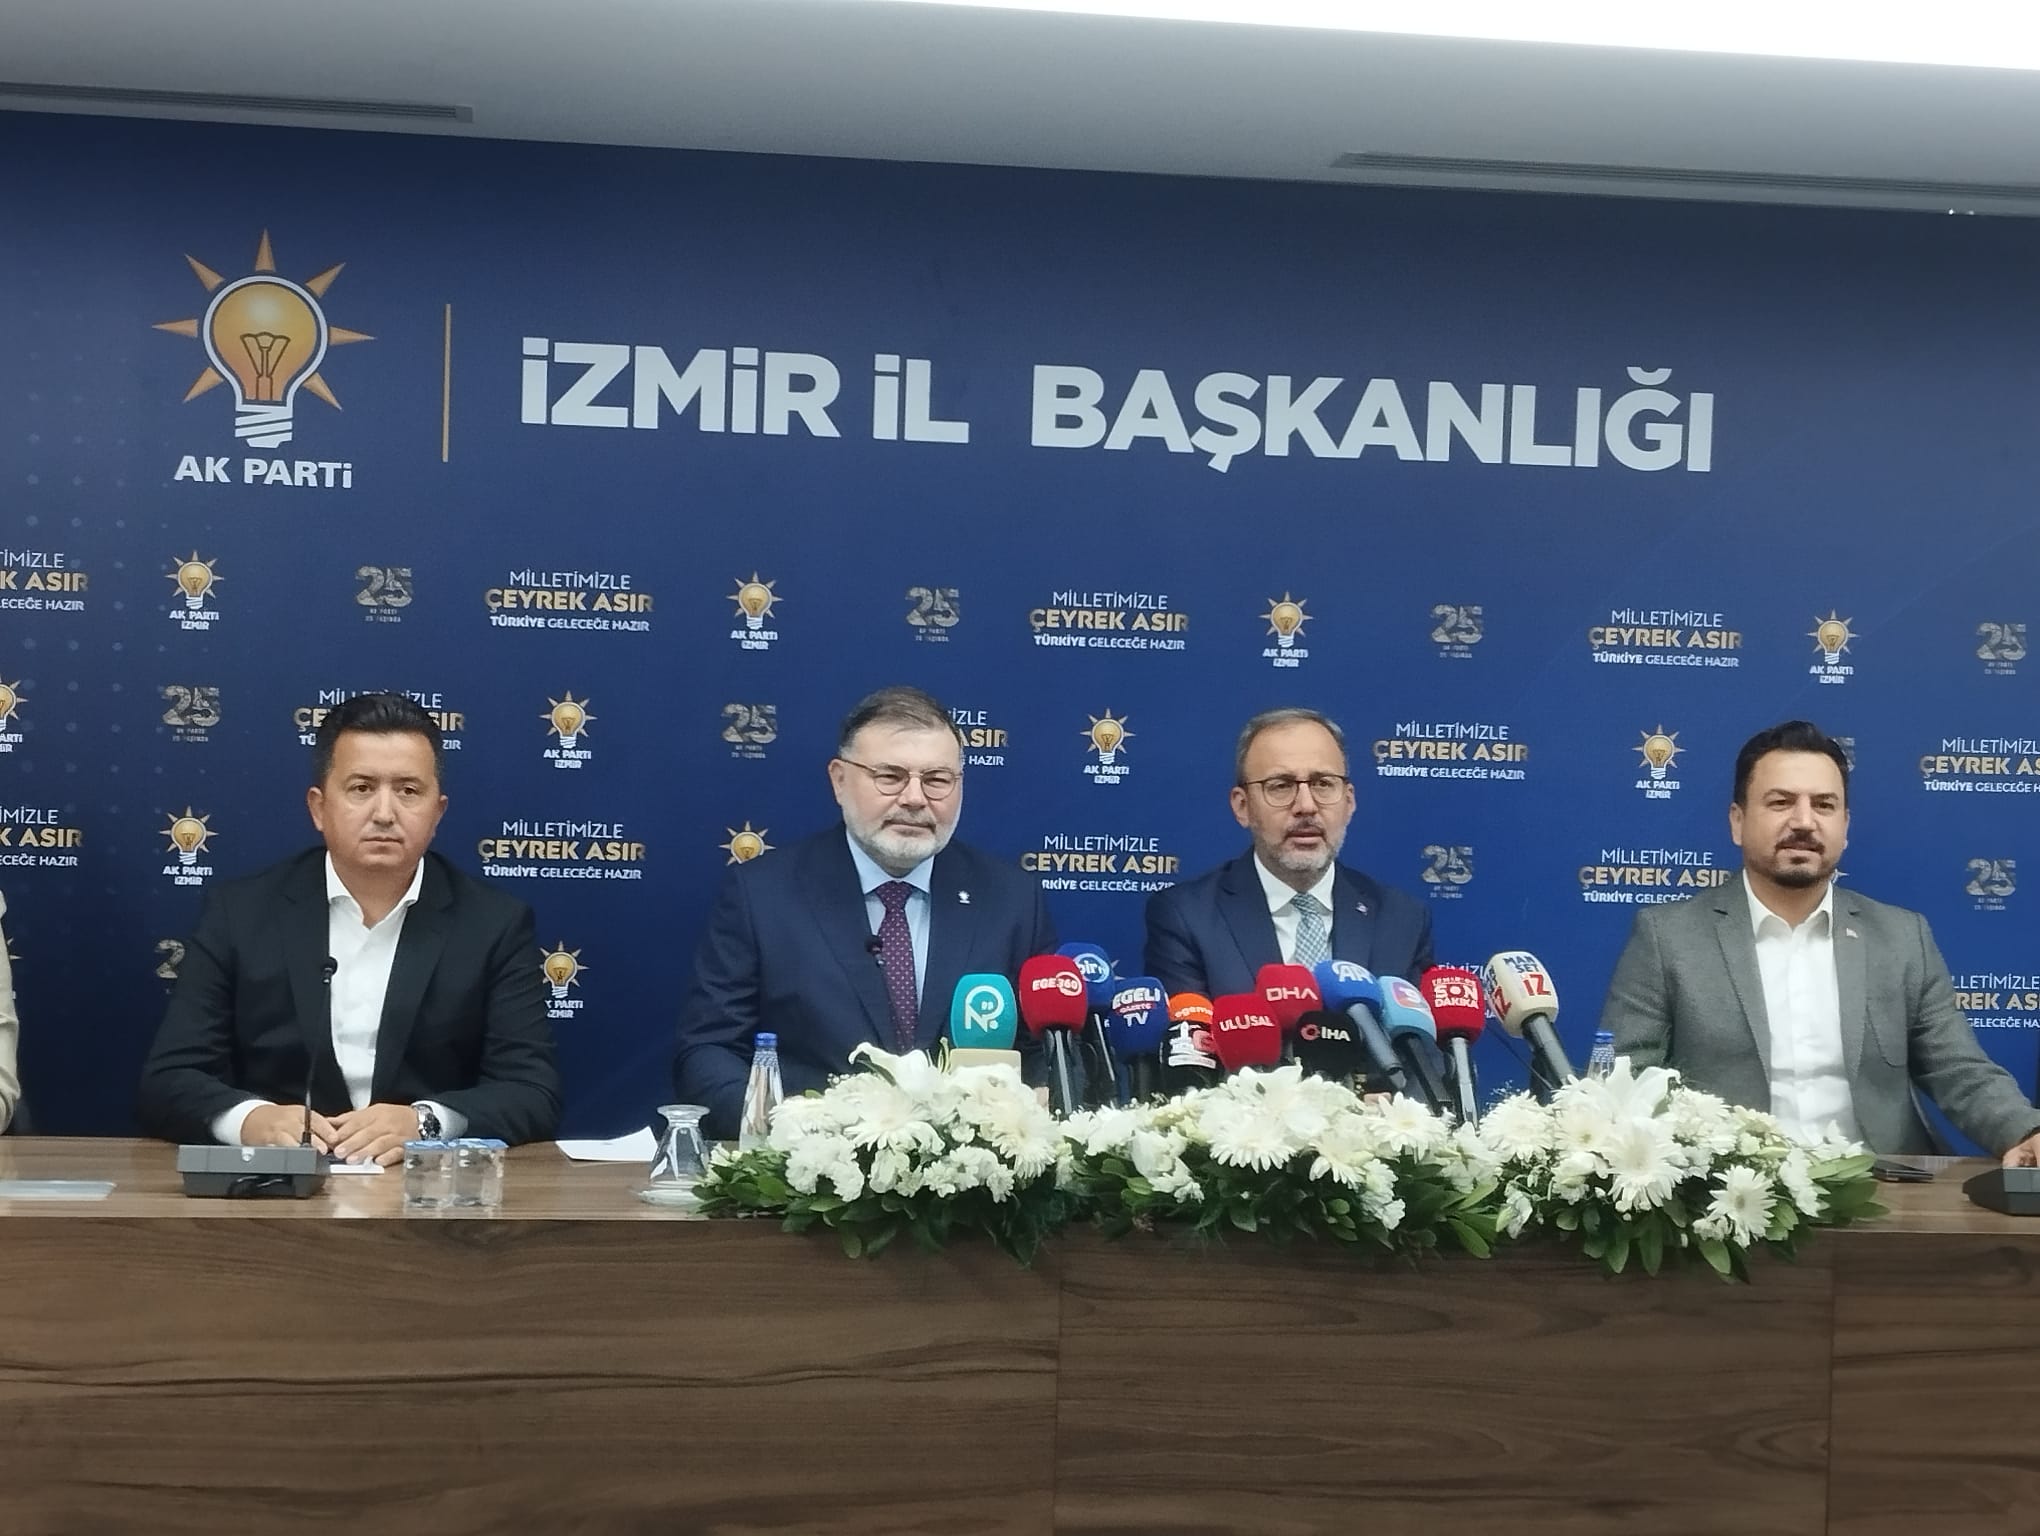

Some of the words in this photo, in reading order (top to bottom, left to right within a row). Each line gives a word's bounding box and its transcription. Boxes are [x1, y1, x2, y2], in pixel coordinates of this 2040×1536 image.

[1031, 365, 1713, 473] BAŞKANLIĞI
[174, 456, 231, 482] AK
[509, 569, 630, 592] MİLLETİMİZLE
[0, 597, 42, 609] ECEĞE
[46, 600, 84, 610] HAZIR
[486, 589, 586, 615] ÇEYREK
[592, 593, 654, 612] ASIR
[1052, 589, 1167, 611] MİLLETİMİZLE
[169, 610, 186, 621] AK
[1030, 607, 1125, 634] ÇEYREK
[1131, 613, 1189, 631] ASIR
[1611, 608, 1723, 629] MİLLETİMİZLE
[612, 620, 649, 631] HAZIR
[731, 630, 747, 641] AK
[1150, 639, 1185, 649] HAZIR
[1591, 627, 1682, 650] ÇEYREK
[1687, 630, 1743, 649] ASIR
[1263, 649, 1279, 659] AK
[1705, 657, 1739, 667] HAZIR
[1810, 666, 1824, 676] AK
[1395, 720, 1509, 743] MİLLETİMİZLE
[442, 739, 462, 750] ZIR
[544, 749, 560, 758] AK
[1375, 741, 1466, 763] ÇEYREK
[1472, 744, 1529, 761] ASIR
[1943, 737, 2040, 754] MİLLETİMİZL
[969, 755, 1004, 765] HAZIR
[1922, 756, 2011, 778] ÇEYREK
[1084, 765, 1100, 776] AK
[1490, 769, 1525, 779] HAZIR
[1635, 780, 1651, 788] AK
[503, 819, 623, 838] MİLLETİMİZLE
[1045, 833, 1159, 852] MİLLETİMİZLE
[39, 856, 77, 866] HAZIR
[479, 839, 579, 865] ÇEYREK
[585, 842, 647, 861] ASIR
[1602, 847, 1712, 865] MİLLETİMİZLE
[163, 866, 179, 875] AK
[1122, 855, 1180, 874] ASIR
[605, 869, 641, 879] HAZIR
[1581, 867, 1672, 891] ÇEYREK
[1042, 878, 1077, 889] RKİYE
[155, 939, 186, 979] 2
[1951, 972, 2040, 991] LLETİMİZLE
[1266, 986, 1319, 1002] DHA
[1955, 992, 2001, 1011] REK
[1123, 1010, 1149, 1028] TV
[1219, 1014, 1275, 1032] ULUSAL
